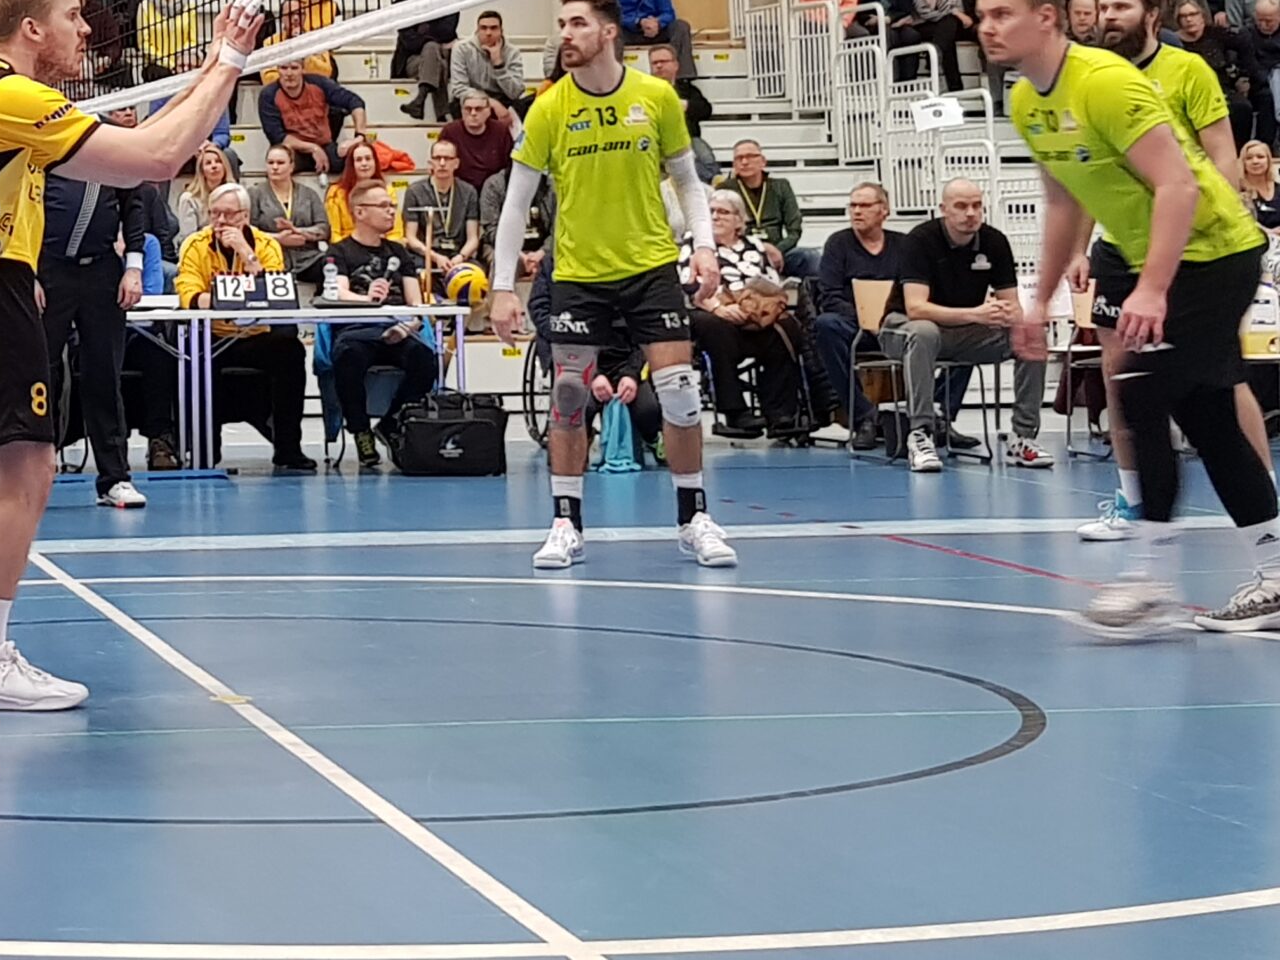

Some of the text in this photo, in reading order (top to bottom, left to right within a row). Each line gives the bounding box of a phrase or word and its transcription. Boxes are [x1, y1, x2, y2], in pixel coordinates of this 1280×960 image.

[595, 106, 618, 127] 13
[220, 277, 242, 297] 12
[272, 277, 289, 297] 8
[661, 312, 680, 328] 13
[30, 382, 48, 416] 8
